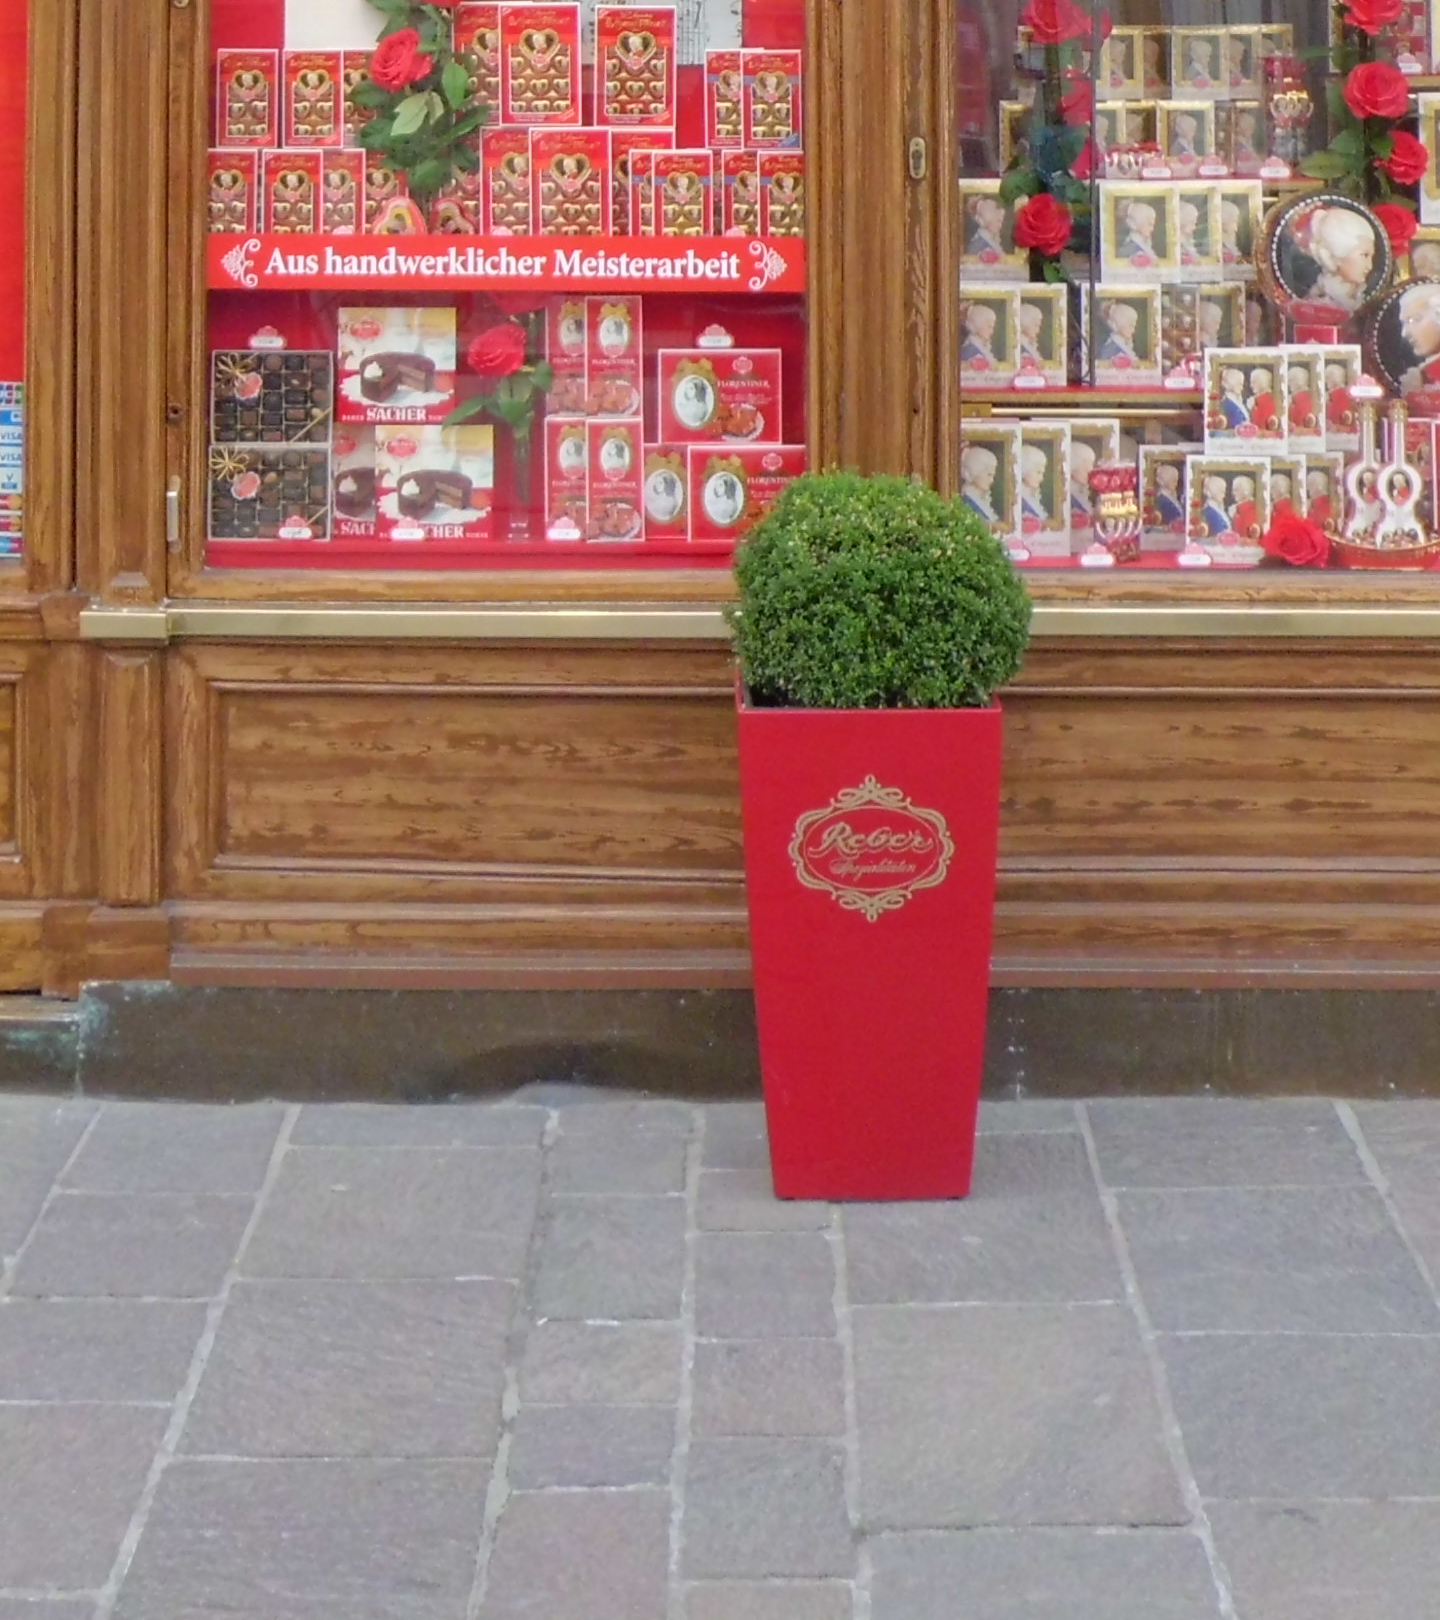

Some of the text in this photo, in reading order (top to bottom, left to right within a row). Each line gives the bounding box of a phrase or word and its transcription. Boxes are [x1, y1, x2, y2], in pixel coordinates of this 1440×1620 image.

[264, 246, 741, 279] Aus handwerklicher Meisterarbeit
[366, 406, 427, 421] SACHER
[809, 822, 934, 859] Reber
